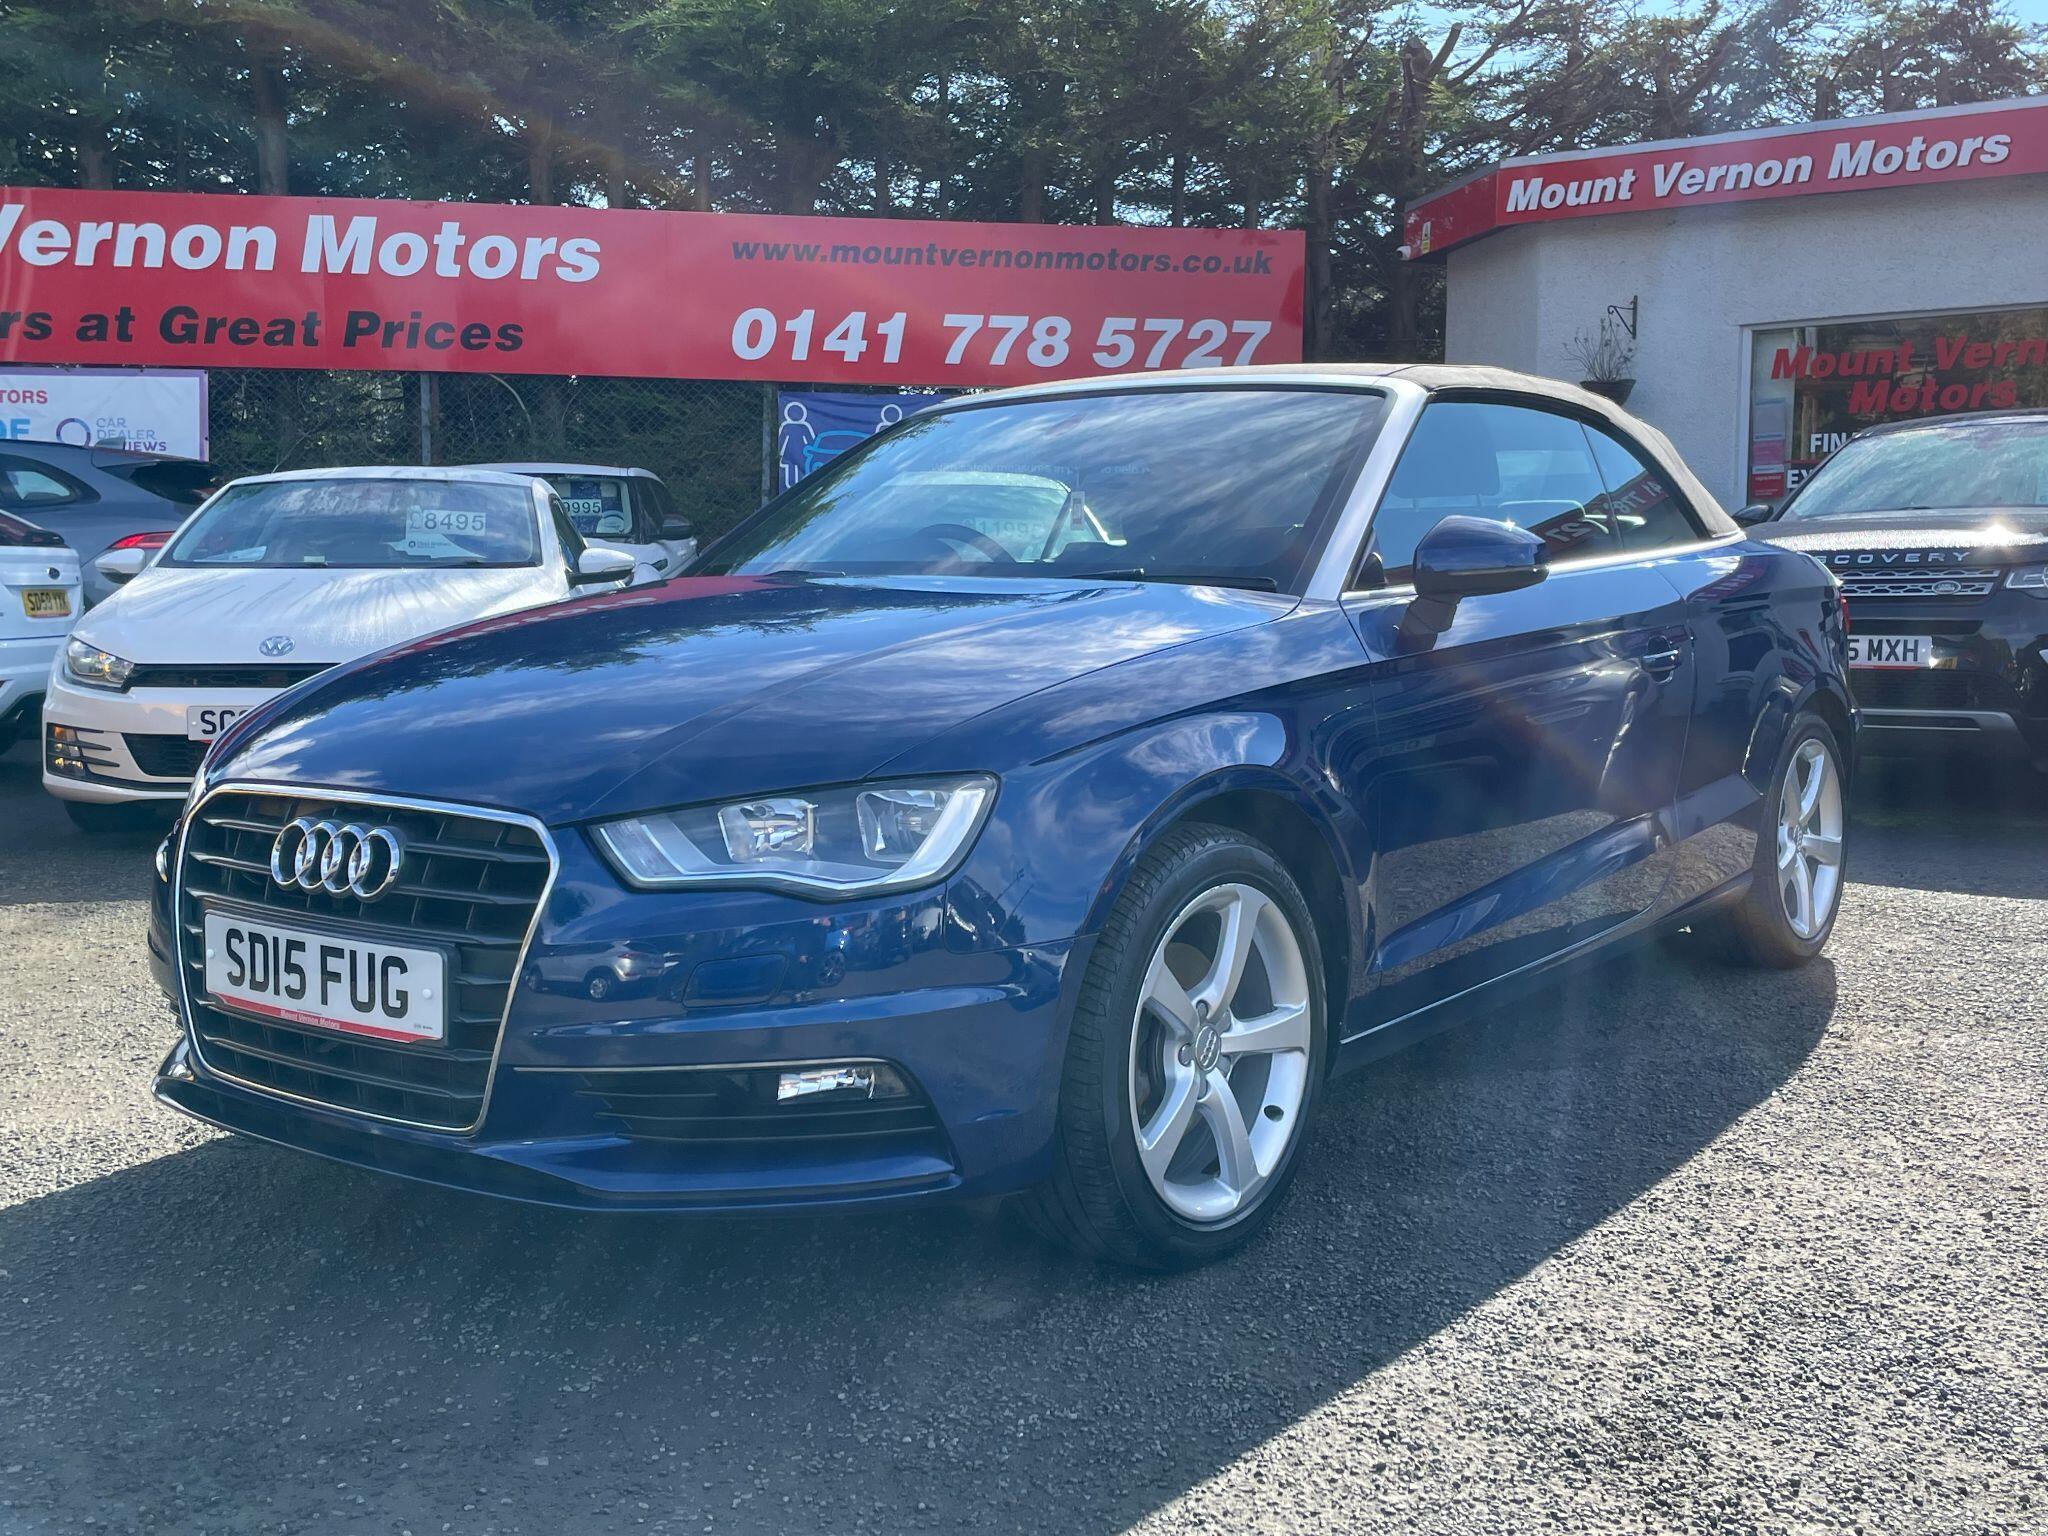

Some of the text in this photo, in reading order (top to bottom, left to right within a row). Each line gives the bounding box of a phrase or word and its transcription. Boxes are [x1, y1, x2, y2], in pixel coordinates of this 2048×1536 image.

[1505, 133, 2011, 214] Mount Vernon Motors
[300, 214, 601, 282] Motors
[731, 240, 1272, 275] www.mountvernonmotors.co.uk
[75, 306, 136, 343] at
[159, 305, 321, 348] Great
[343, 310, 524, 352] Prices
[731, 307, 1272, 369] 0141 778 5727
[1771, 340, 1914, 381] Mount
[1848, 378, 2017, 414] Motors
[96, 417, 127, 428] CAR
[96, 429, 156, 440] DEALER
[124, 441, 167, 452] IEWS
[1810, 432, 1859, 453] FIN
[409, 511, 485, 532] £8495
[1867, 639, 1919, 662] MXH
[226, 927, 409, 1019] SD15 FUG
